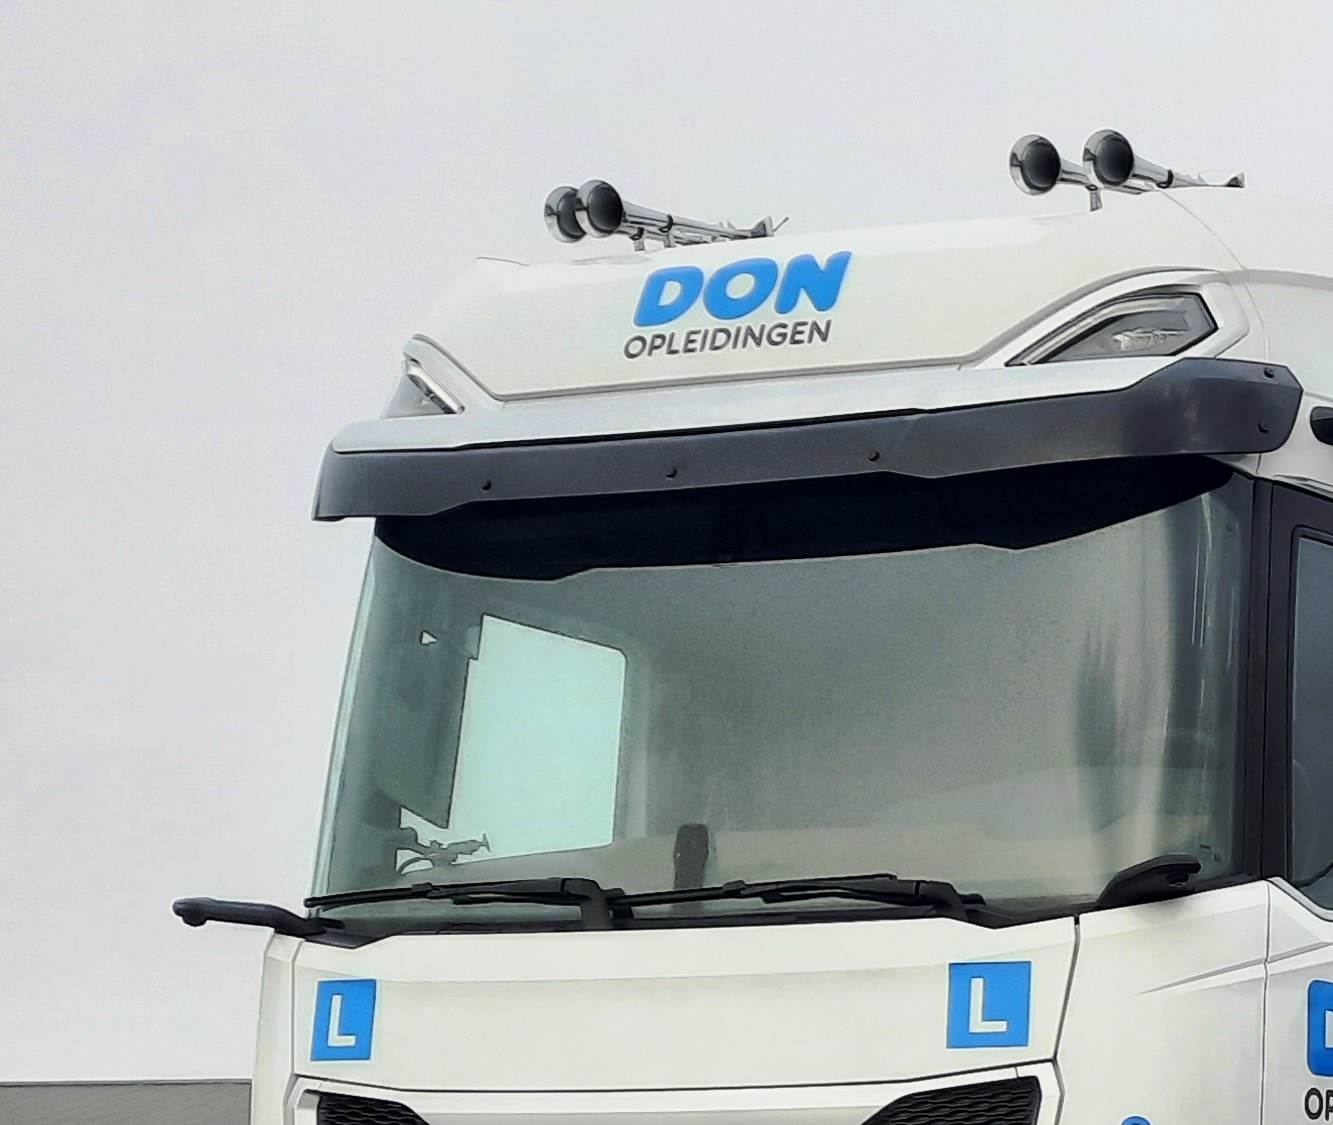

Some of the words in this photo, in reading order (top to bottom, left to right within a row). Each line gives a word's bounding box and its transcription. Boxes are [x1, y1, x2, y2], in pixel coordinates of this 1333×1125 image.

[634, 251, 852, 327] DON
[624, 319, 832, 359] OPLEIDINGEN
[327, 994, 357, 1047] L
[969, 977, 1008, 1033] L
